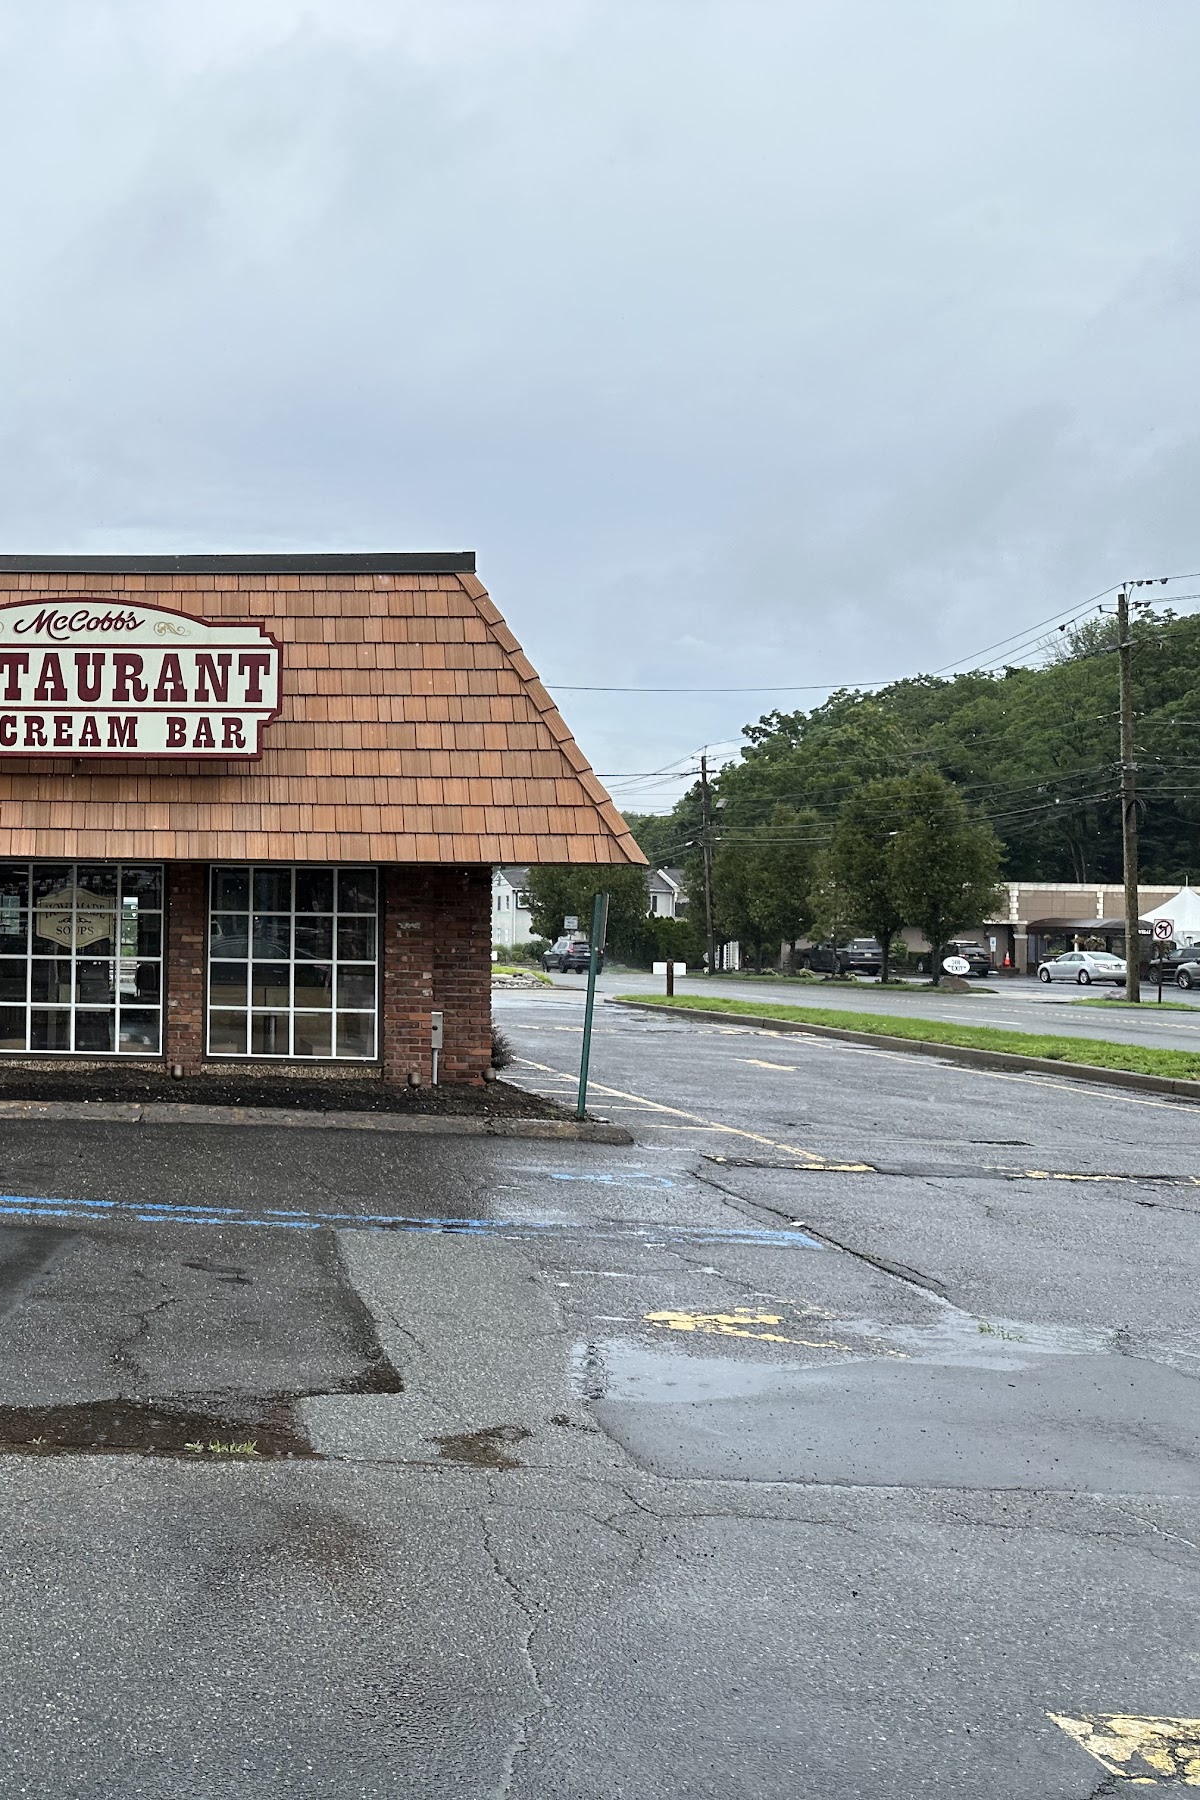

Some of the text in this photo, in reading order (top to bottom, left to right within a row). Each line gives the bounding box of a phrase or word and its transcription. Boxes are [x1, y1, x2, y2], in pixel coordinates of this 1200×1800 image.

[12, 609, 146, 641] McCobb's
[0, 715, 138, 748] CREAM
[166, 717, 246, 748] BAR
